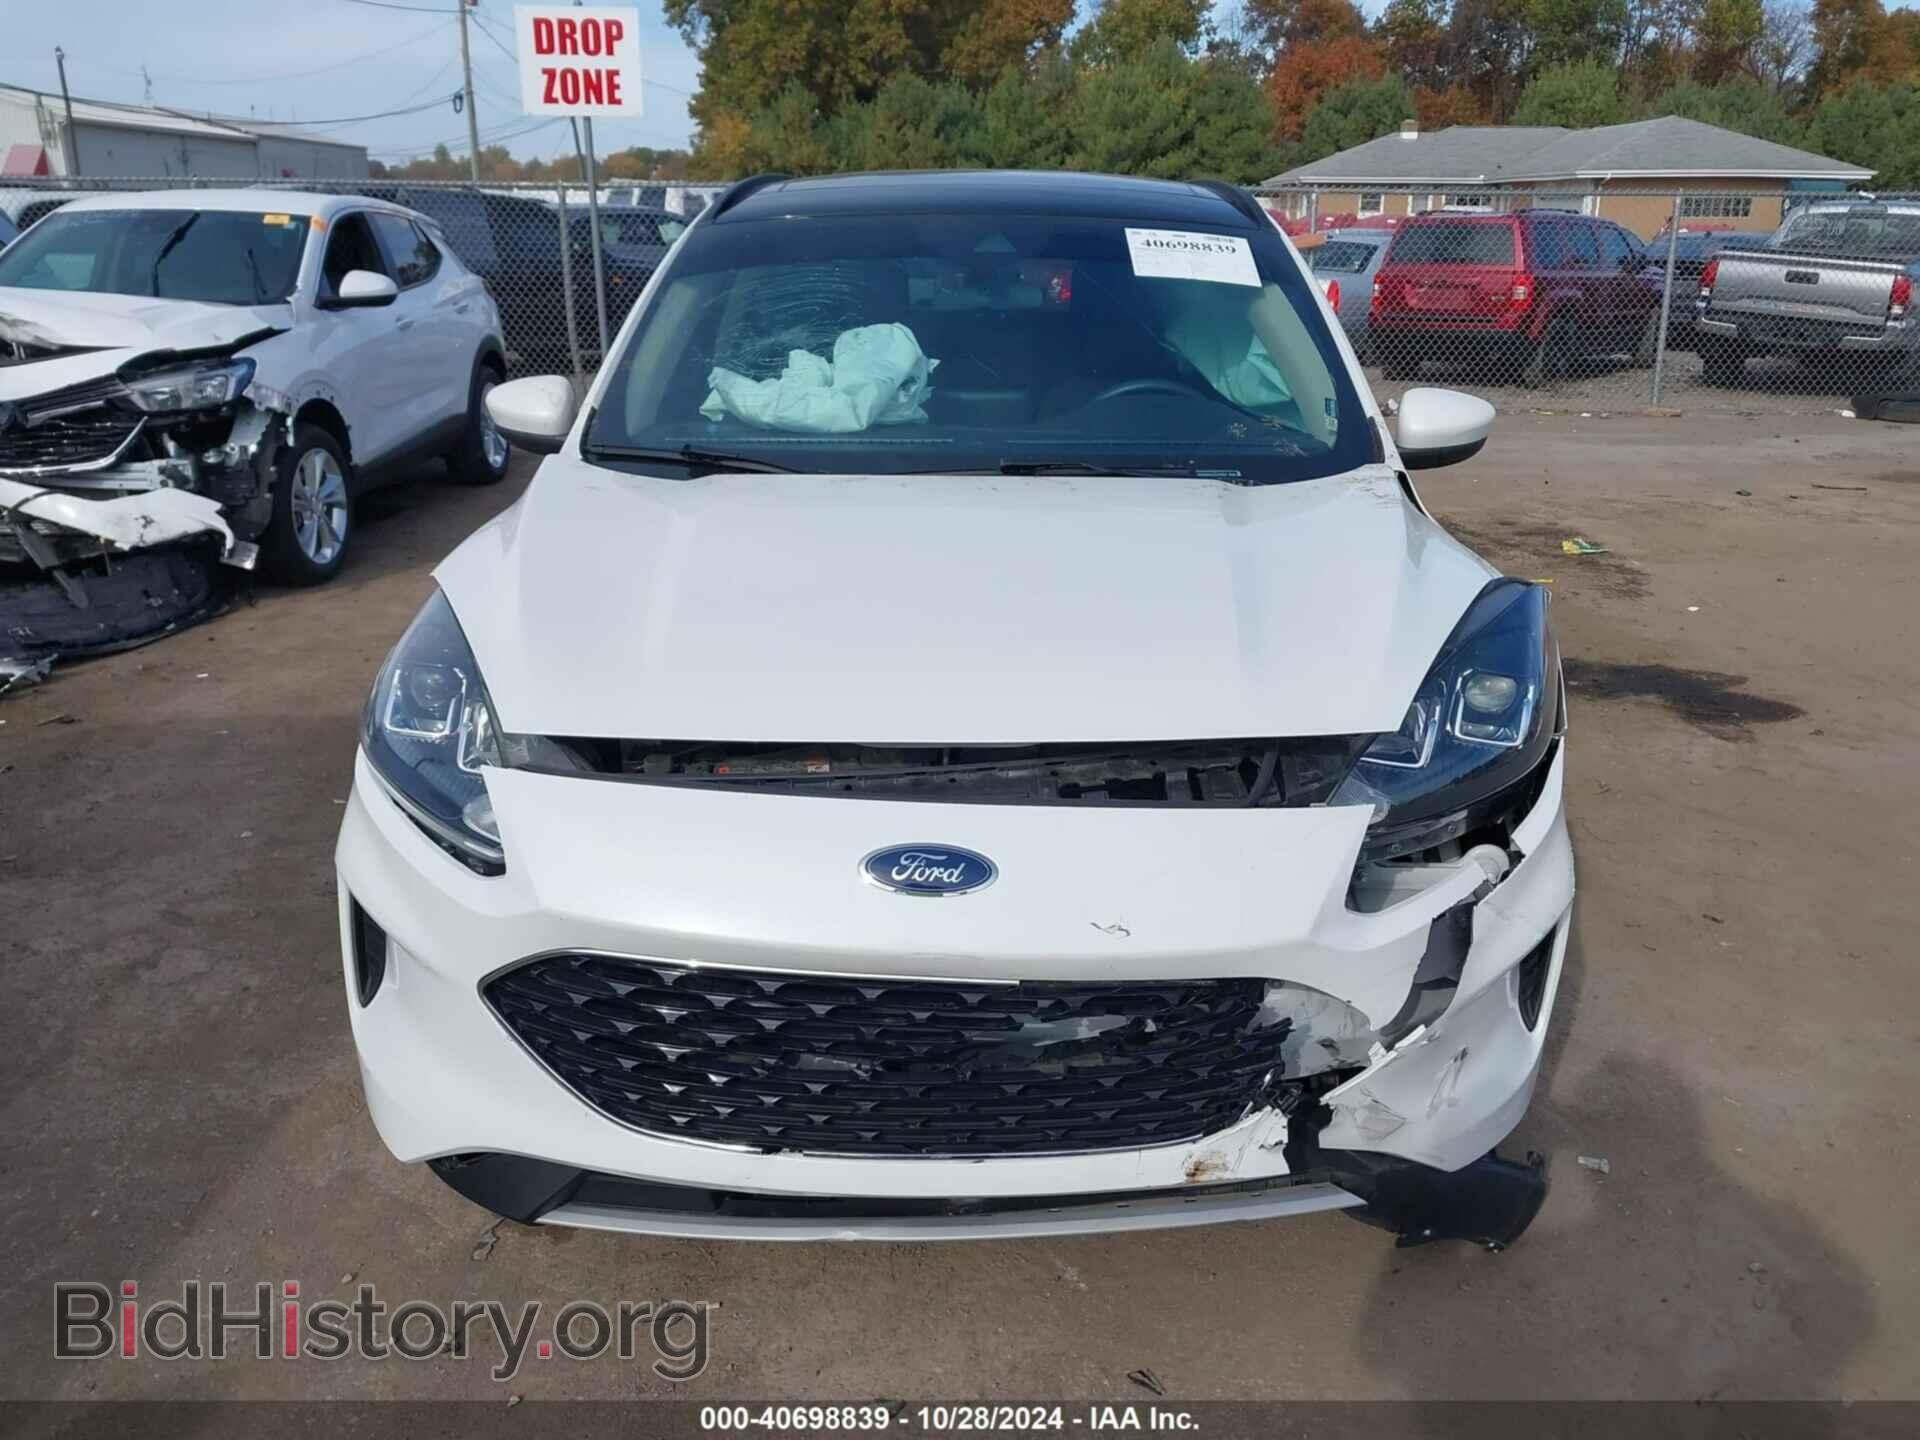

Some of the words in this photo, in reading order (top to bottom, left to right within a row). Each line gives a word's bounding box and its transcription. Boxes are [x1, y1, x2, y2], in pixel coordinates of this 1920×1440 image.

[532, 17, 624, 56] DROP
[541, 67, 623, 105] ZONE
[1141, 239, 1236, 254] 40698839
[891, 852, 966, 883] Ford
